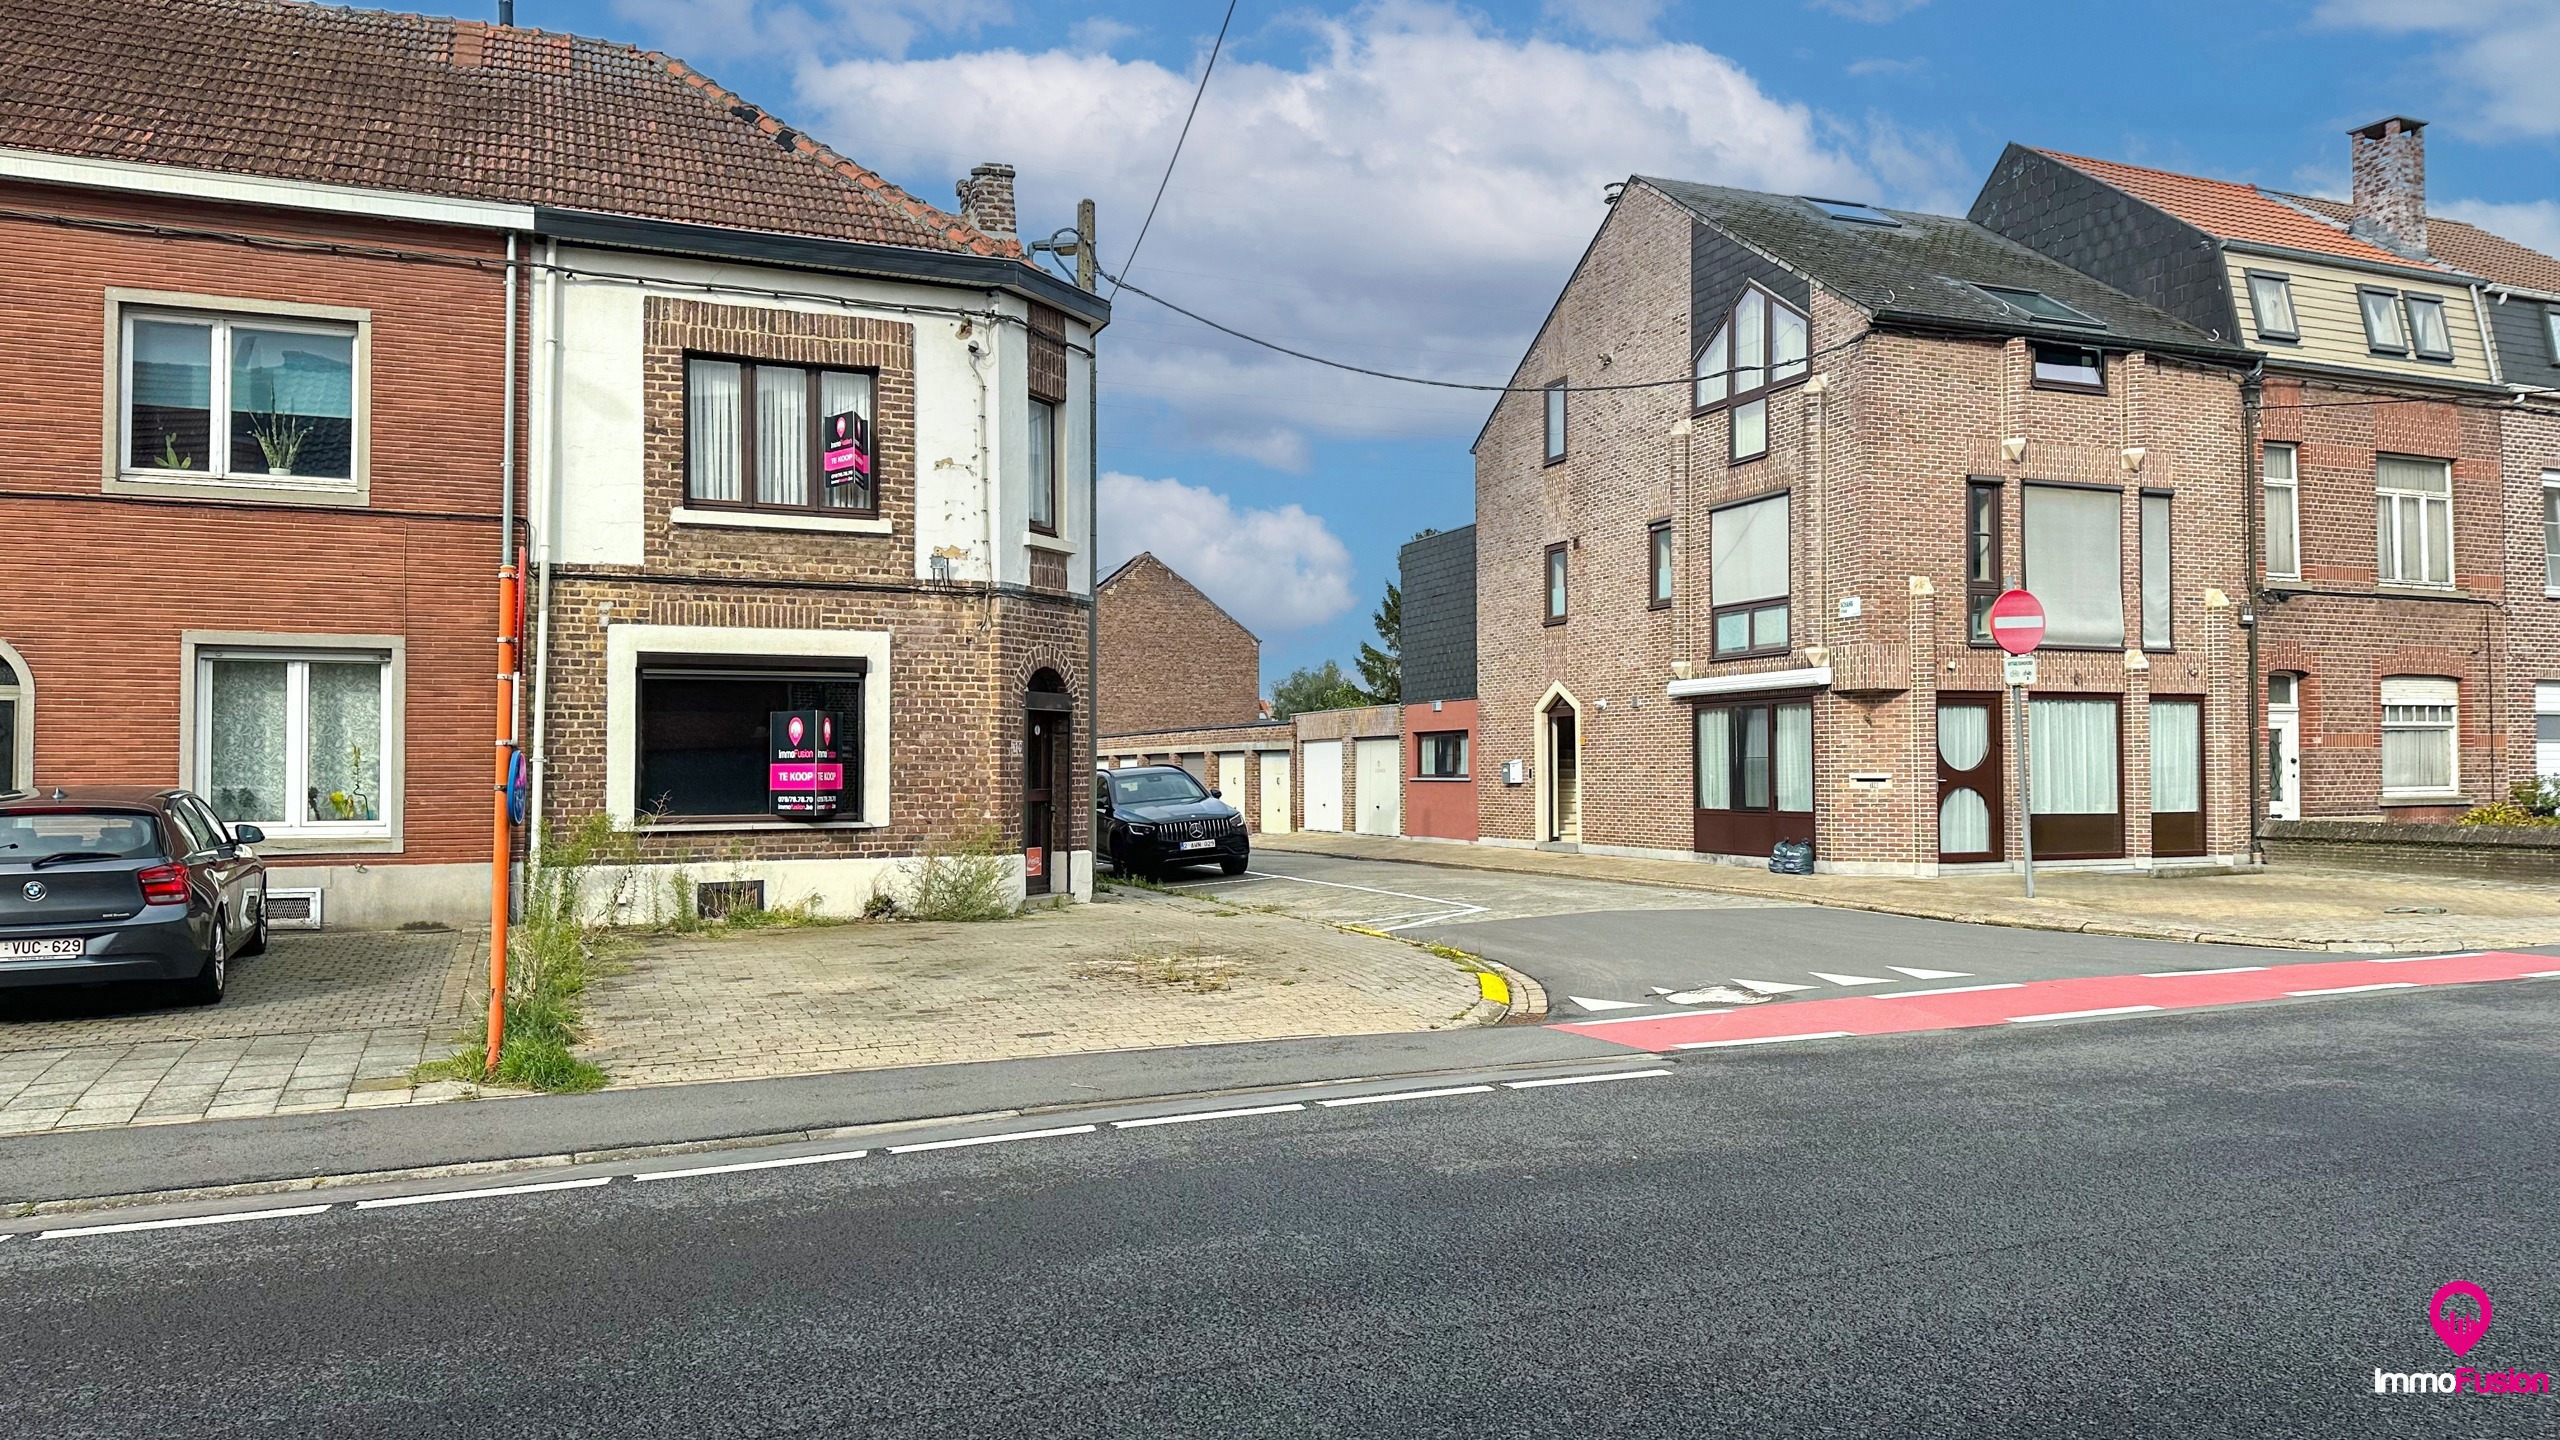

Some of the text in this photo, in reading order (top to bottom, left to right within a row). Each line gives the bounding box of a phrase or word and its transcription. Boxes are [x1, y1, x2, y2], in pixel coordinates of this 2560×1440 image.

[838, 454, 853, 463] KOOP
[778, 749, 814, 759] ImmoFusion
[778, 772, 814, 781] TE KOOP
[817, 772, 837, 781] TE KOOP
